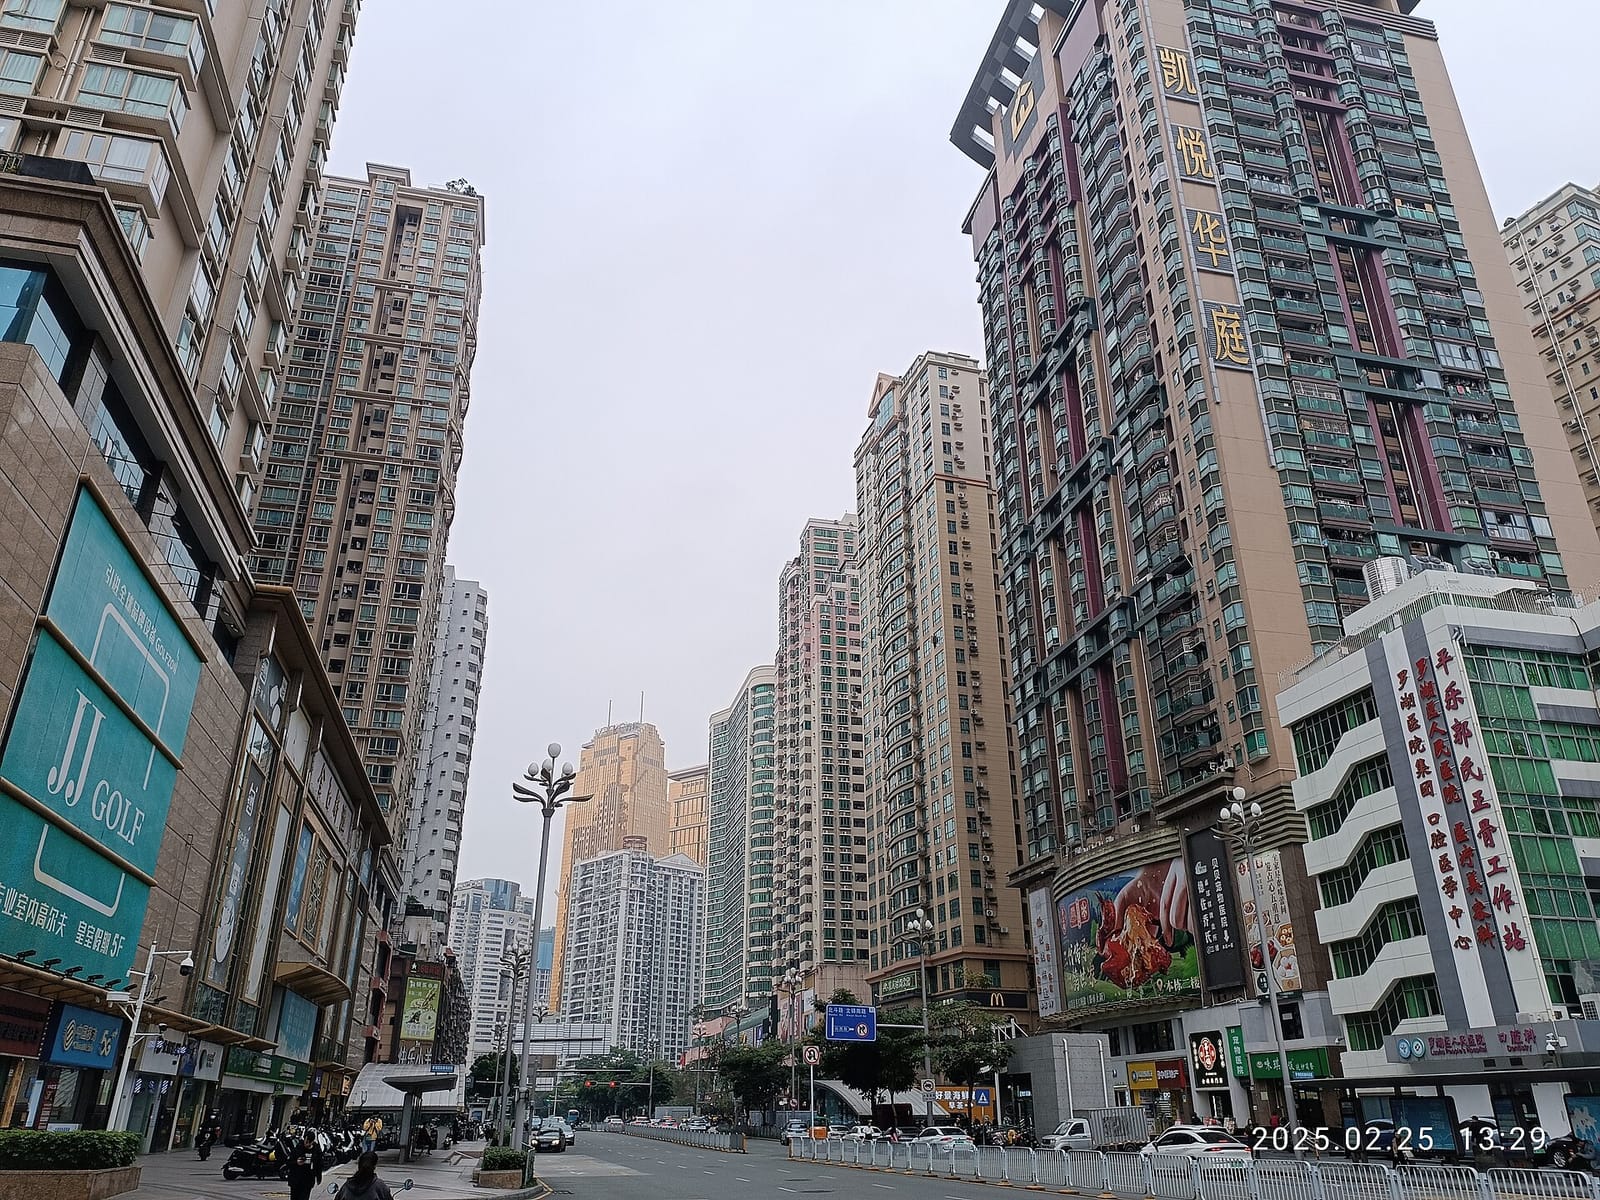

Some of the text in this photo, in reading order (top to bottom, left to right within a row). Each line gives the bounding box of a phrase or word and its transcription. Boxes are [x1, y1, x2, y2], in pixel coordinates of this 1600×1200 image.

[1159, 48, 1250, 365] 凯悦华庭
[47, 688, 146, 847] JJ GOLF
[1396, 668, 1473, 951] 罗湖医院集团 口腔医学中心
[1414, 655, 1498, 950] 罗湖区人民医院 医疗美容科
[1435, 646, 1527, 952] 平乐郭氏正骨工作站
[110, 932, 126, 957] 5F
[1211, 857, 1229, 928] 贝贝宠物医院
[1232, 1036, 1245, 1075] 宠物医院
[1428, 1028, 1537, 1049] 罗湖区人民医院 口腔科
